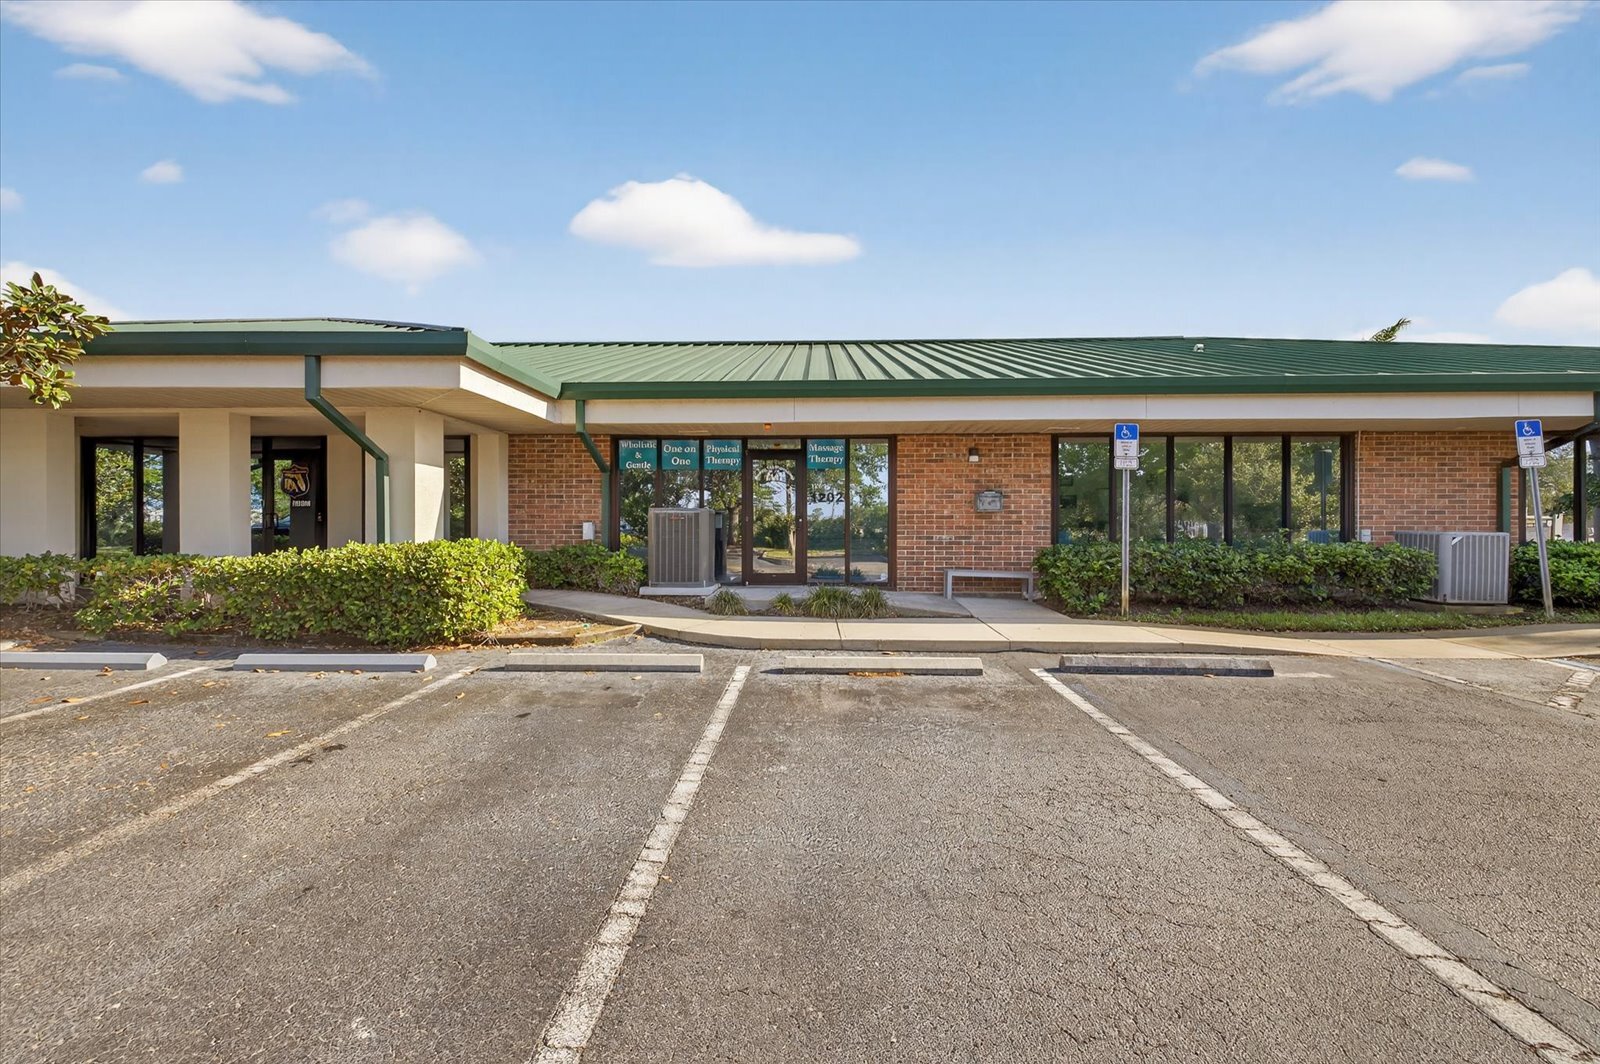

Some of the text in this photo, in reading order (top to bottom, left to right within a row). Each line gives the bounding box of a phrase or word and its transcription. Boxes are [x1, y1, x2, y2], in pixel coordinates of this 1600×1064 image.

[663, 444, 683, 453] One
[706, 444, 740, 455] Physical
[808, 443, 844, 454] Massage
[634, 451, 642, 459] &
[671, 456, 691, 465] One
[705, 455, 741, 466] Therapy
[808, 454, 844, 465] Therapy
[625, 460, 652, 469] Gentle
[811, 492, 845, 503] 1202
